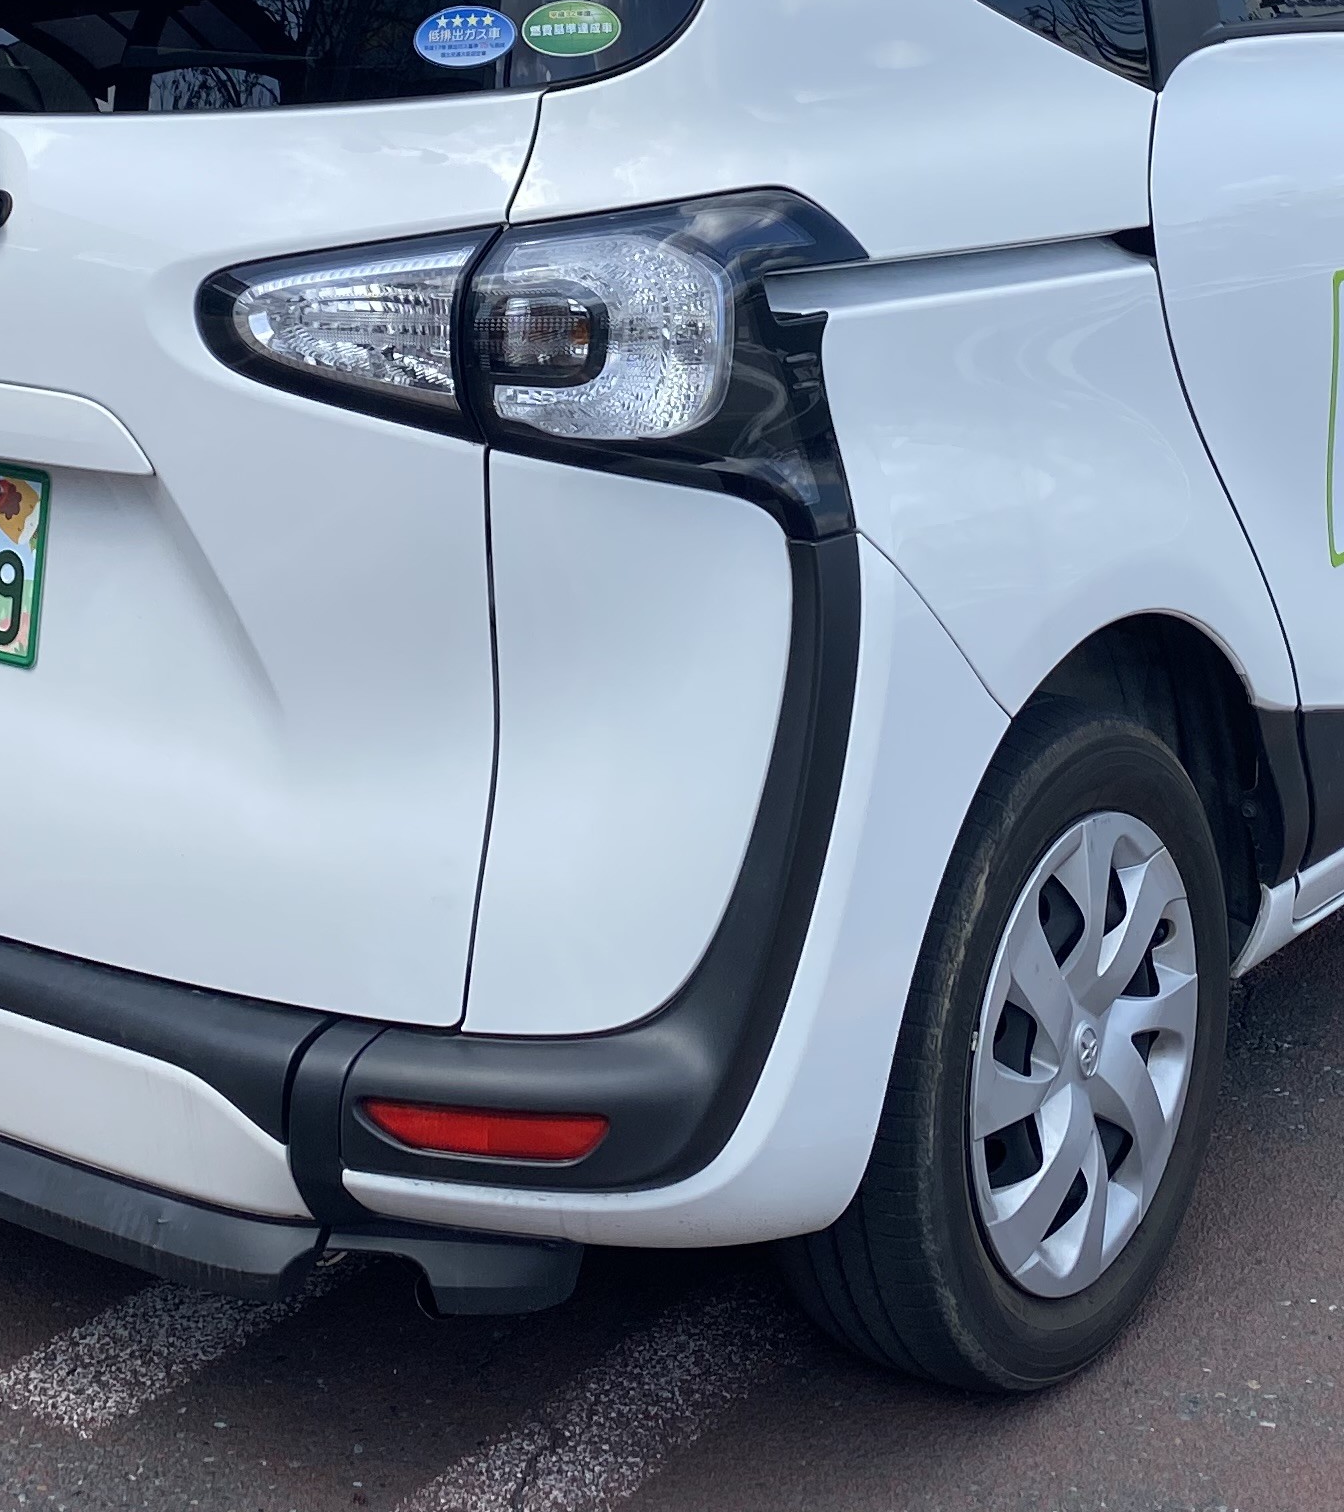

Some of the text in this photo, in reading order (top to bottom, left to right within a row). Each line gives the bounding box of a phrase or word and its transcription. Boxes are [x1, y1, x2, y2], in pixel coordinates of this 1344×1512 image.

[428, 28, 501, 43] 低排出ガス車
